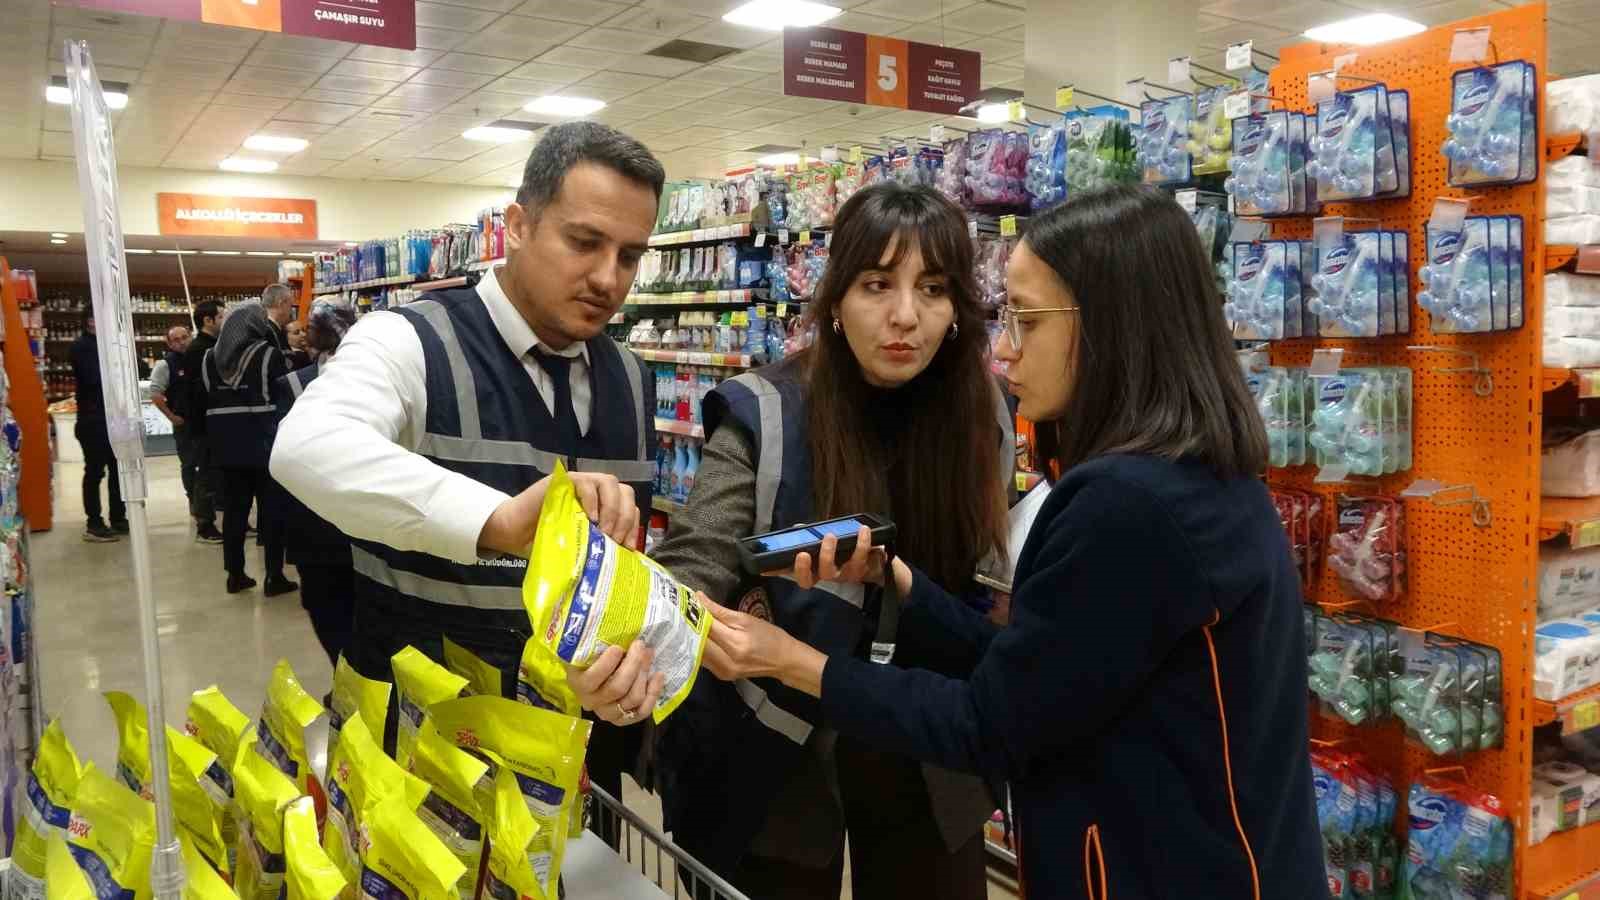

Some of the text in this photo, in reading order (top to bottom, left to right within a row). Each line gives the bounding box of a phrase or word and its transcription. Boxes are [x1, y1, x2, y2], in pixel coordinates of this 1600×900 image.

[314, 9, 385, 28] ÇAMAŞIR SUYU
[877, 54, 898, 92] 5
